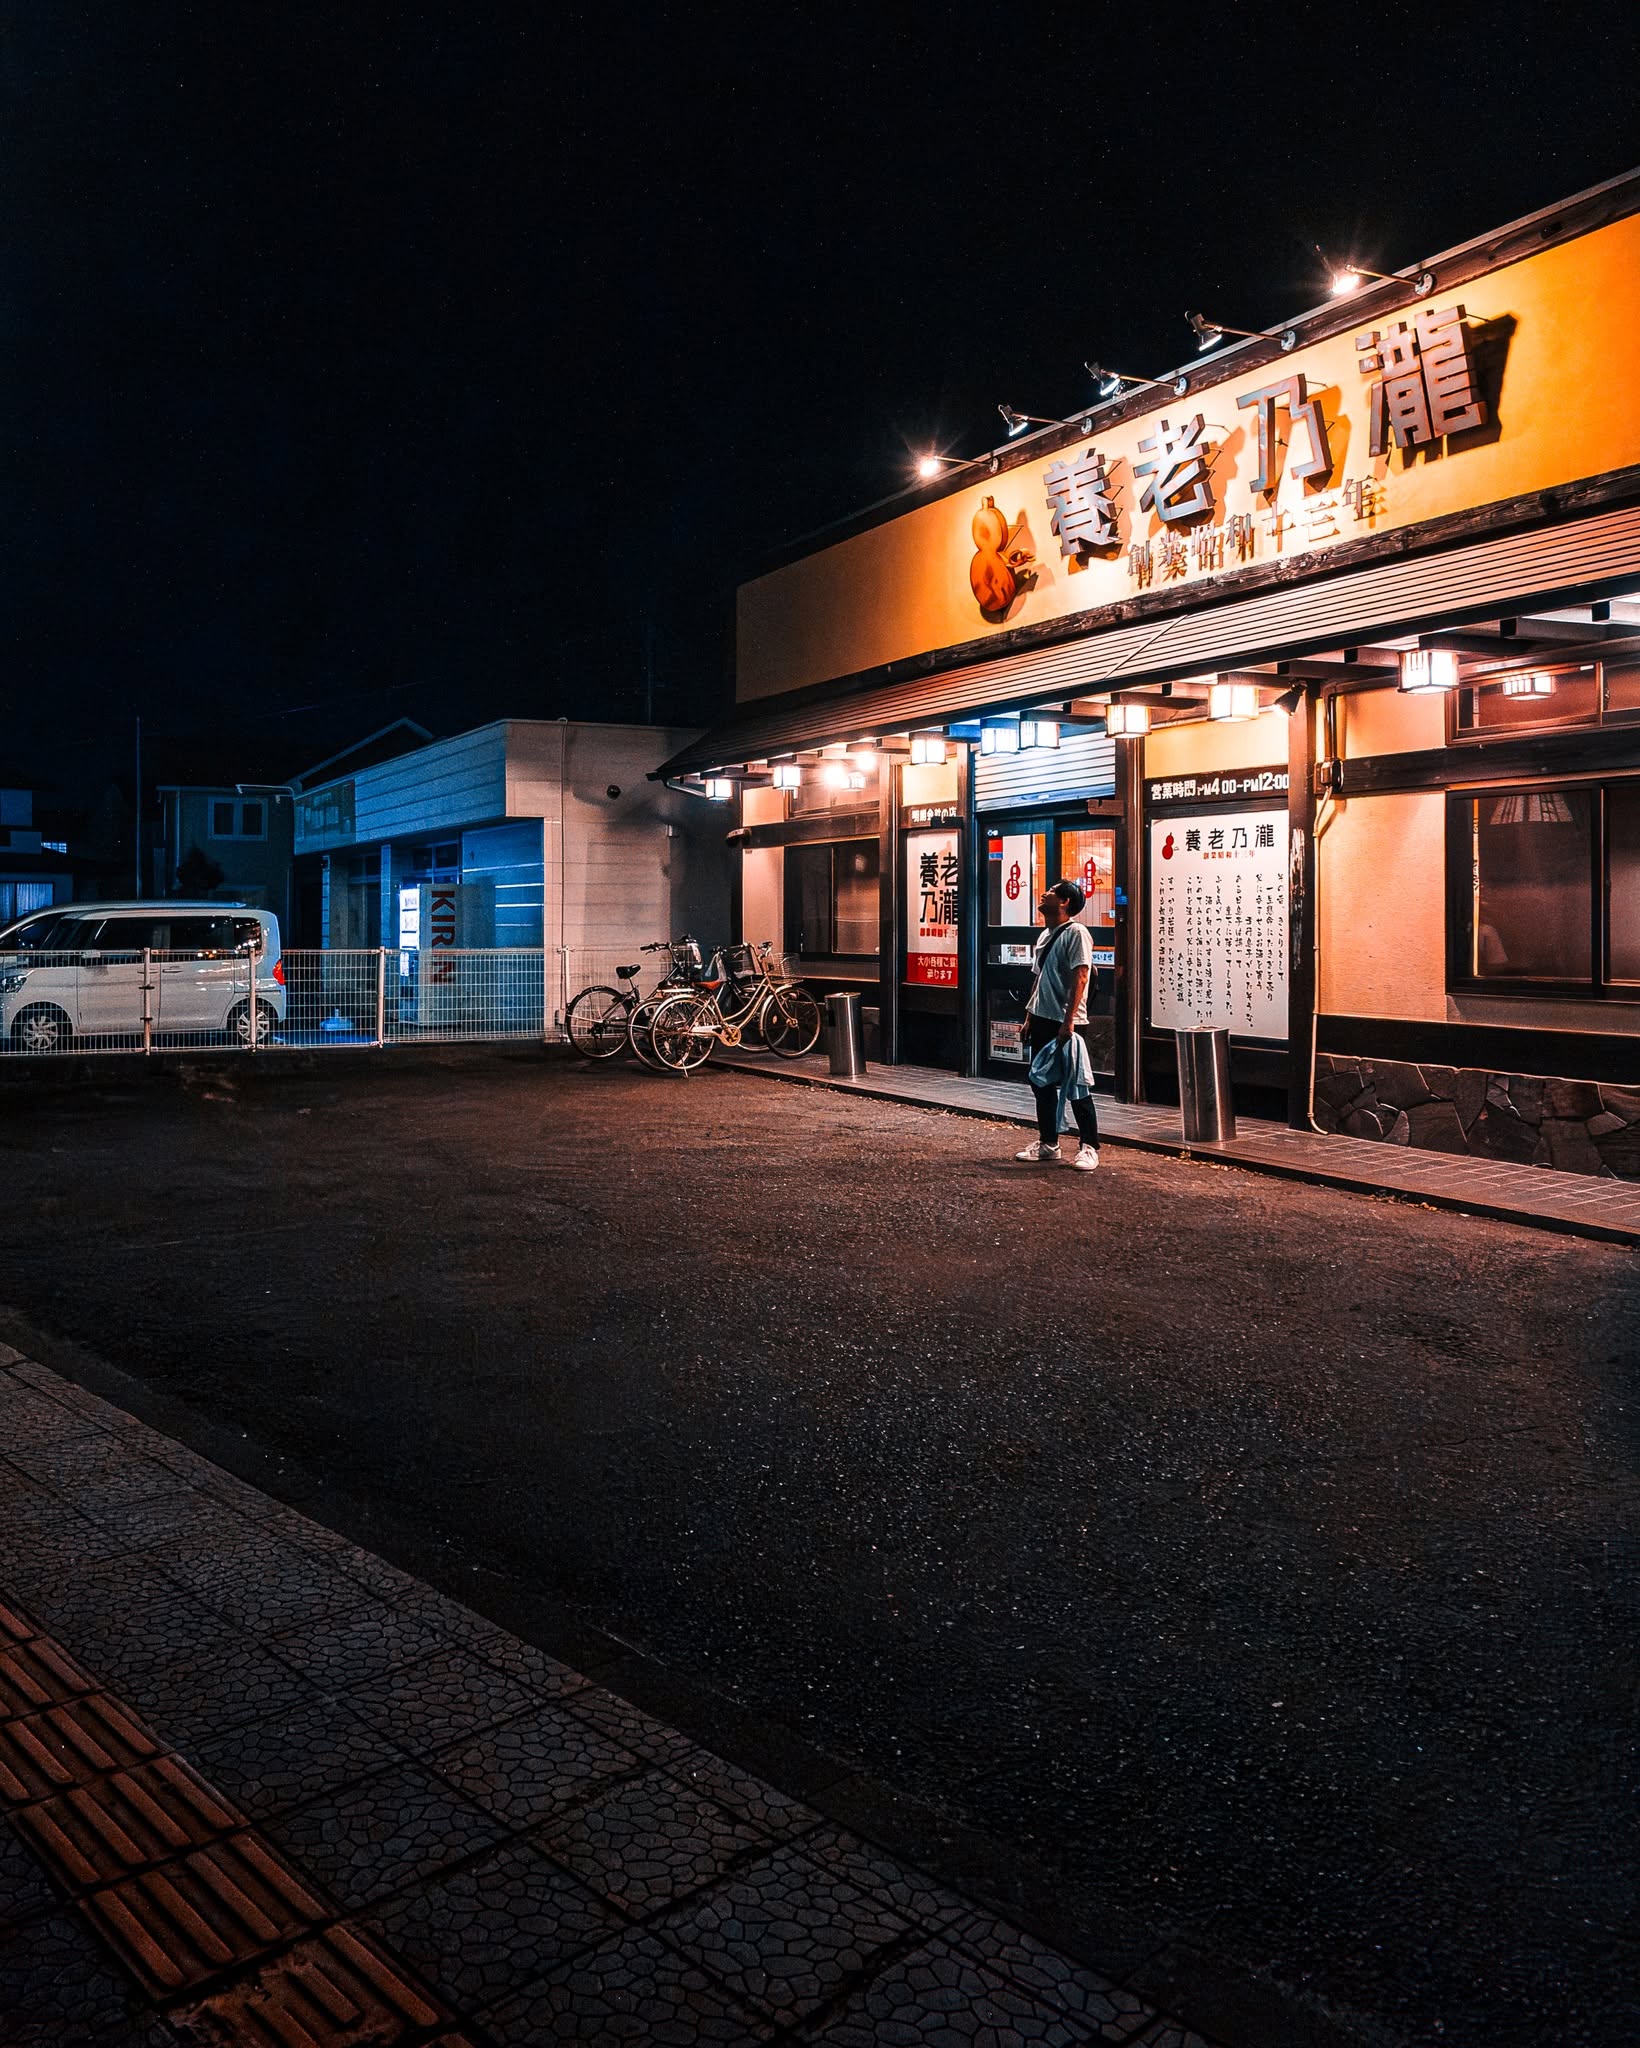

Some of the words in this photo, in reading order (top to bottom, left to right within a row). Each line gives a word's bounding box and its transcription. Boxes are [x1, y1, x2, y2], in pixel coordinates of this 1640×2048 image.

[1043, 304, 1487, 557] 養老乃瀧
[1151, 779, 1197, 800] 営業時間
[1185, 823, 1275, 852] 養老乃瀧
